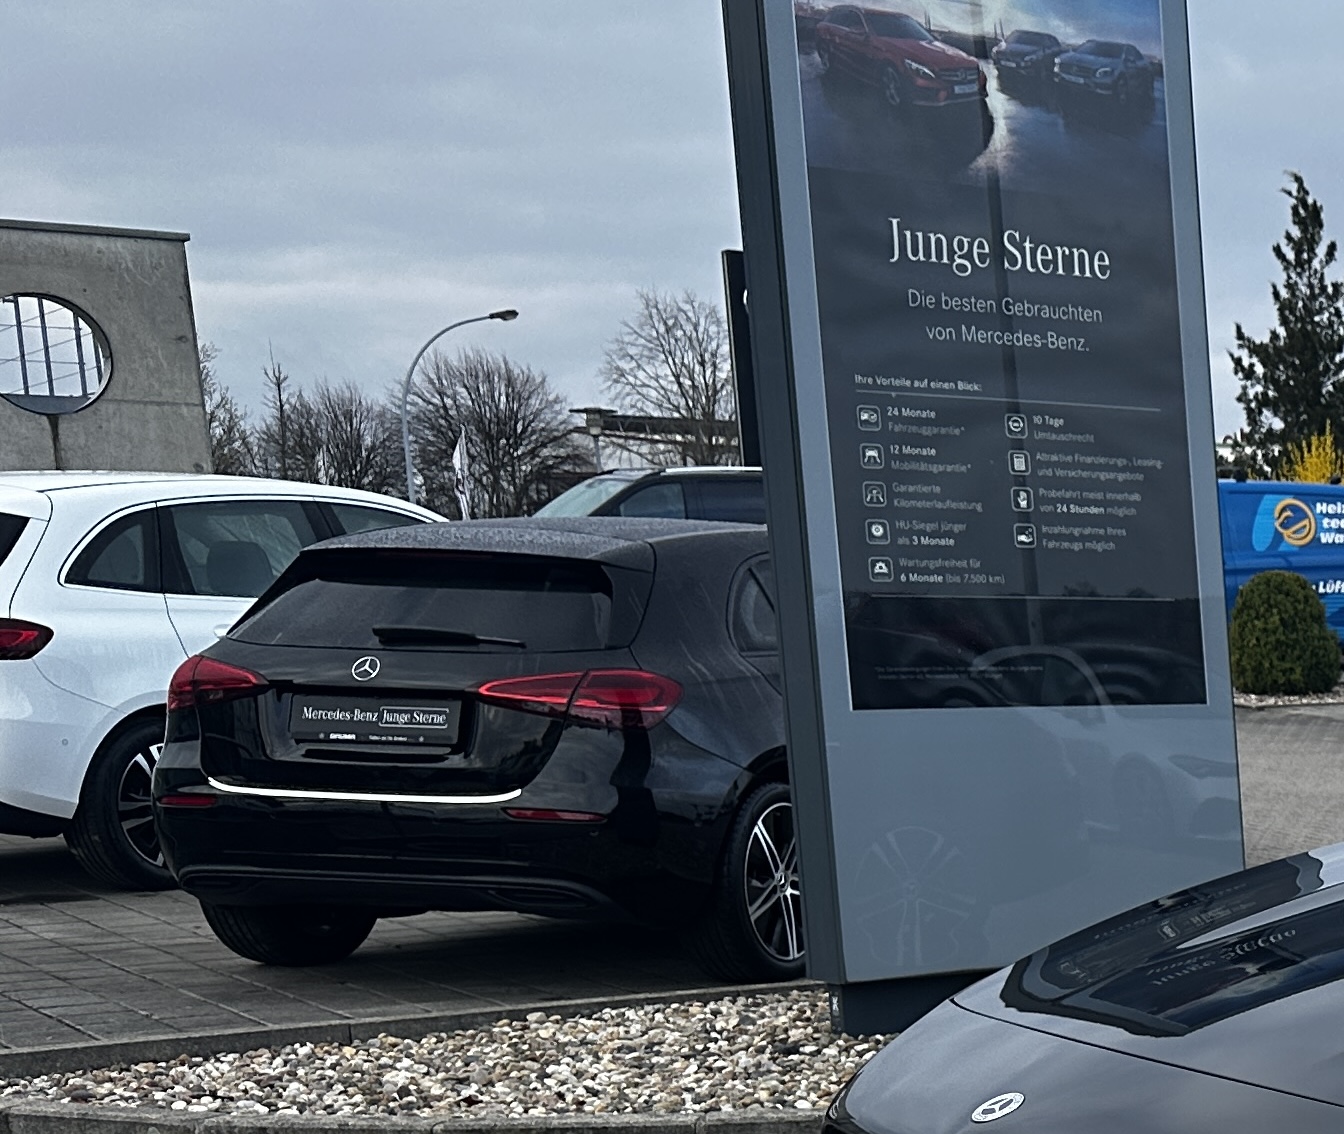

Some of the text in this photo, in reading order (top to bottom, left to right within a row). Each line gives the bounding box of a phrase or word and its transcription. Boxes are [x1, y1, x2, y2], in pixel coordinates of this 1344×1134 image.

[888, 217, 1111, 280] Junge Sterne
[908, 289, 1103, 323] Die besten Gebrauchten
[926, 325, 1090, 352] von Mercedes-Benz.
[854, 374, 874, 385] Ihre
[874, 375, 911, 387] Vorteile
[913, 378, 928, 388] auf
[930, 381, 955, 390] einen
[887, 406, 936, 419] 24 Monate
[1045, 415, 1064, 428] Tage
[889, 445, 936, 456] 12 Monate
[1037, 468, 1052, 477] und
[1039, 505, 1054, 513] von
[1056, 503, 1068, 513] 24
[1069, 504, 1105, 515] Stunden
[912, 535, 918, 545] 3
[920, 536, 955, 547] Monate
[900, 573, 907, 582] 6
[908, 573, 943, 583] Monate
[302, 706, 446, 725] Mercedes-Benz Junge Sterne
